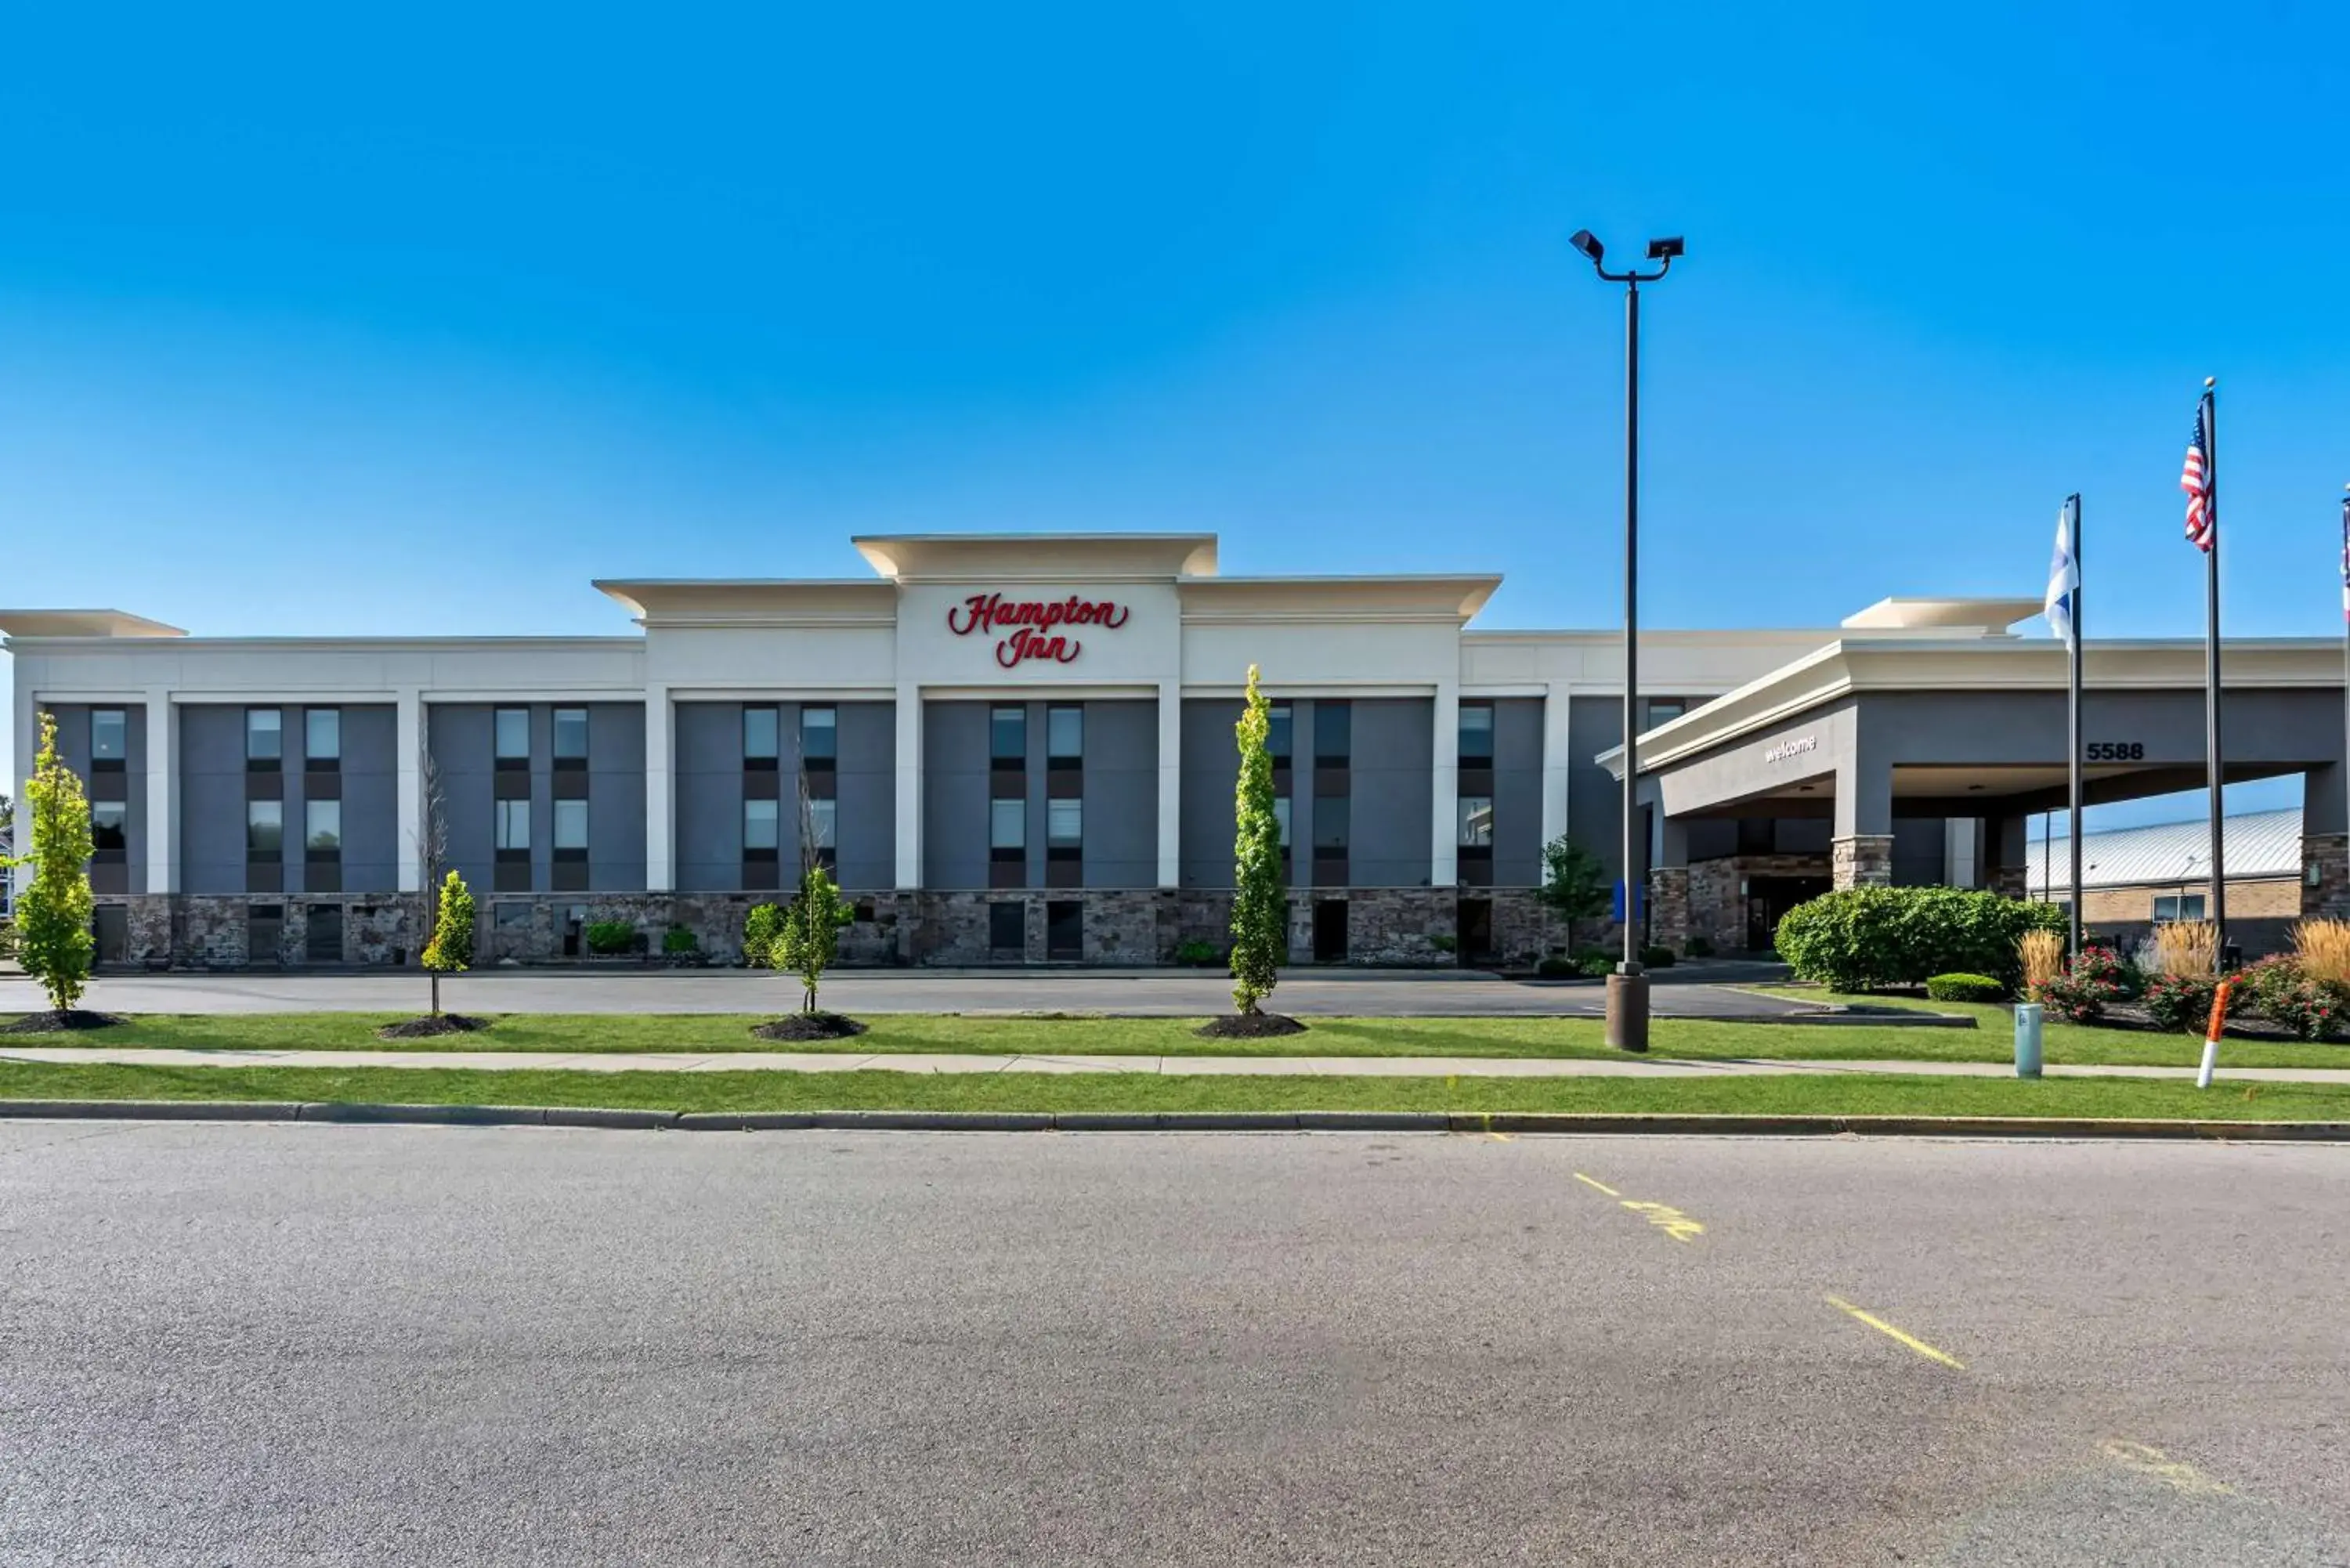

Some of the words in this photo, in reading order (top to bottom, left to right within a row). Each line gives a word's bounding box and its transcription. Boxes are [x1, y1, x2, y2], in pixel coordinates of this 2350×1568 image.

[948, 592, 1129, 635] Hampton
[996, 627, 1080, 668] Inn
[2087, 742, 2144, 761] 5588
